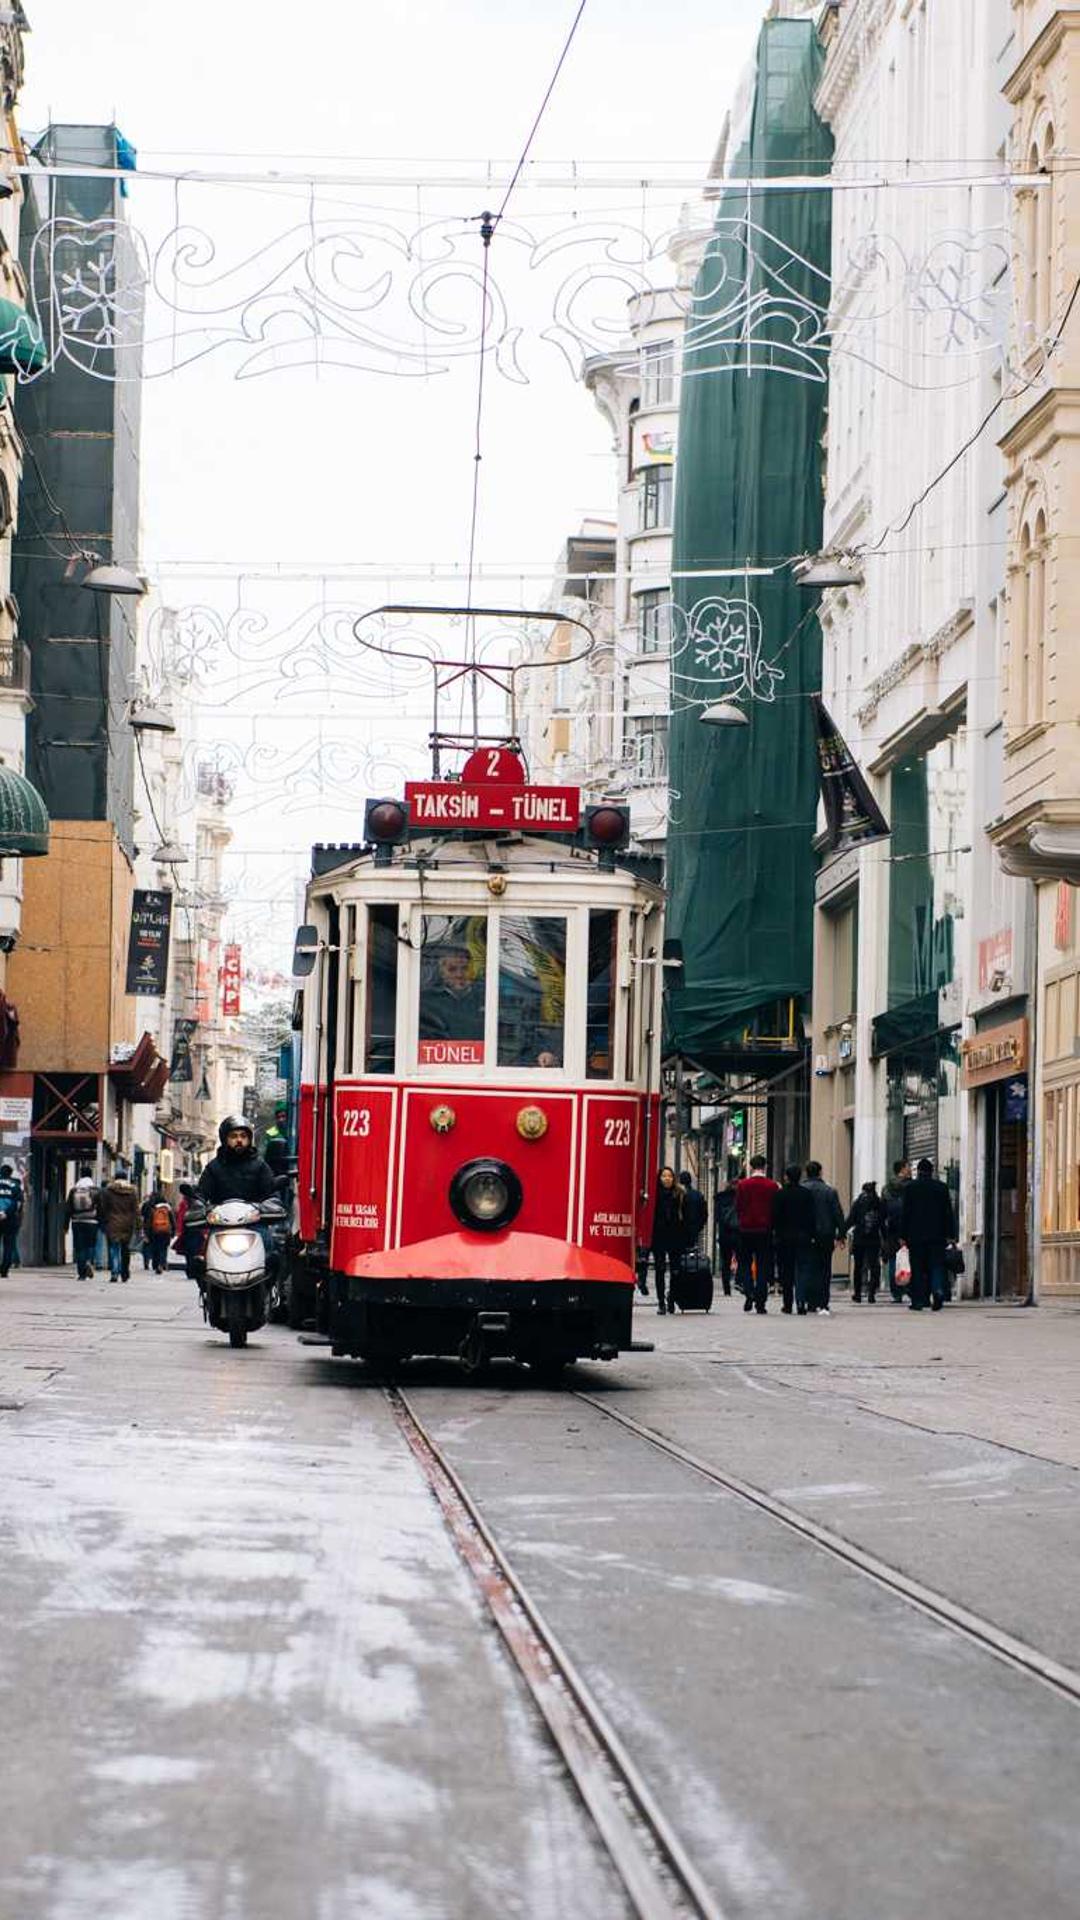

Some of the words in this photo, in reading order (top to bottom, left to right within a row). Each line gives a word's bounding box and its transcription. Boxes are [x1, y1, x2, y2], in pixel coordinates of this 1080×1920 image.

[486, 750, 500, 776] 2
[414, 791, 479, 818] TAKSİM
[512, 793, 573, 822] TÜNEL
[422, 1043, 480, 1062] TÜNEL
[343, 1109, 370, 1136] 223
[604, 1119, 631, 1146] 223
[590, 1225, 601, 1237] VE
